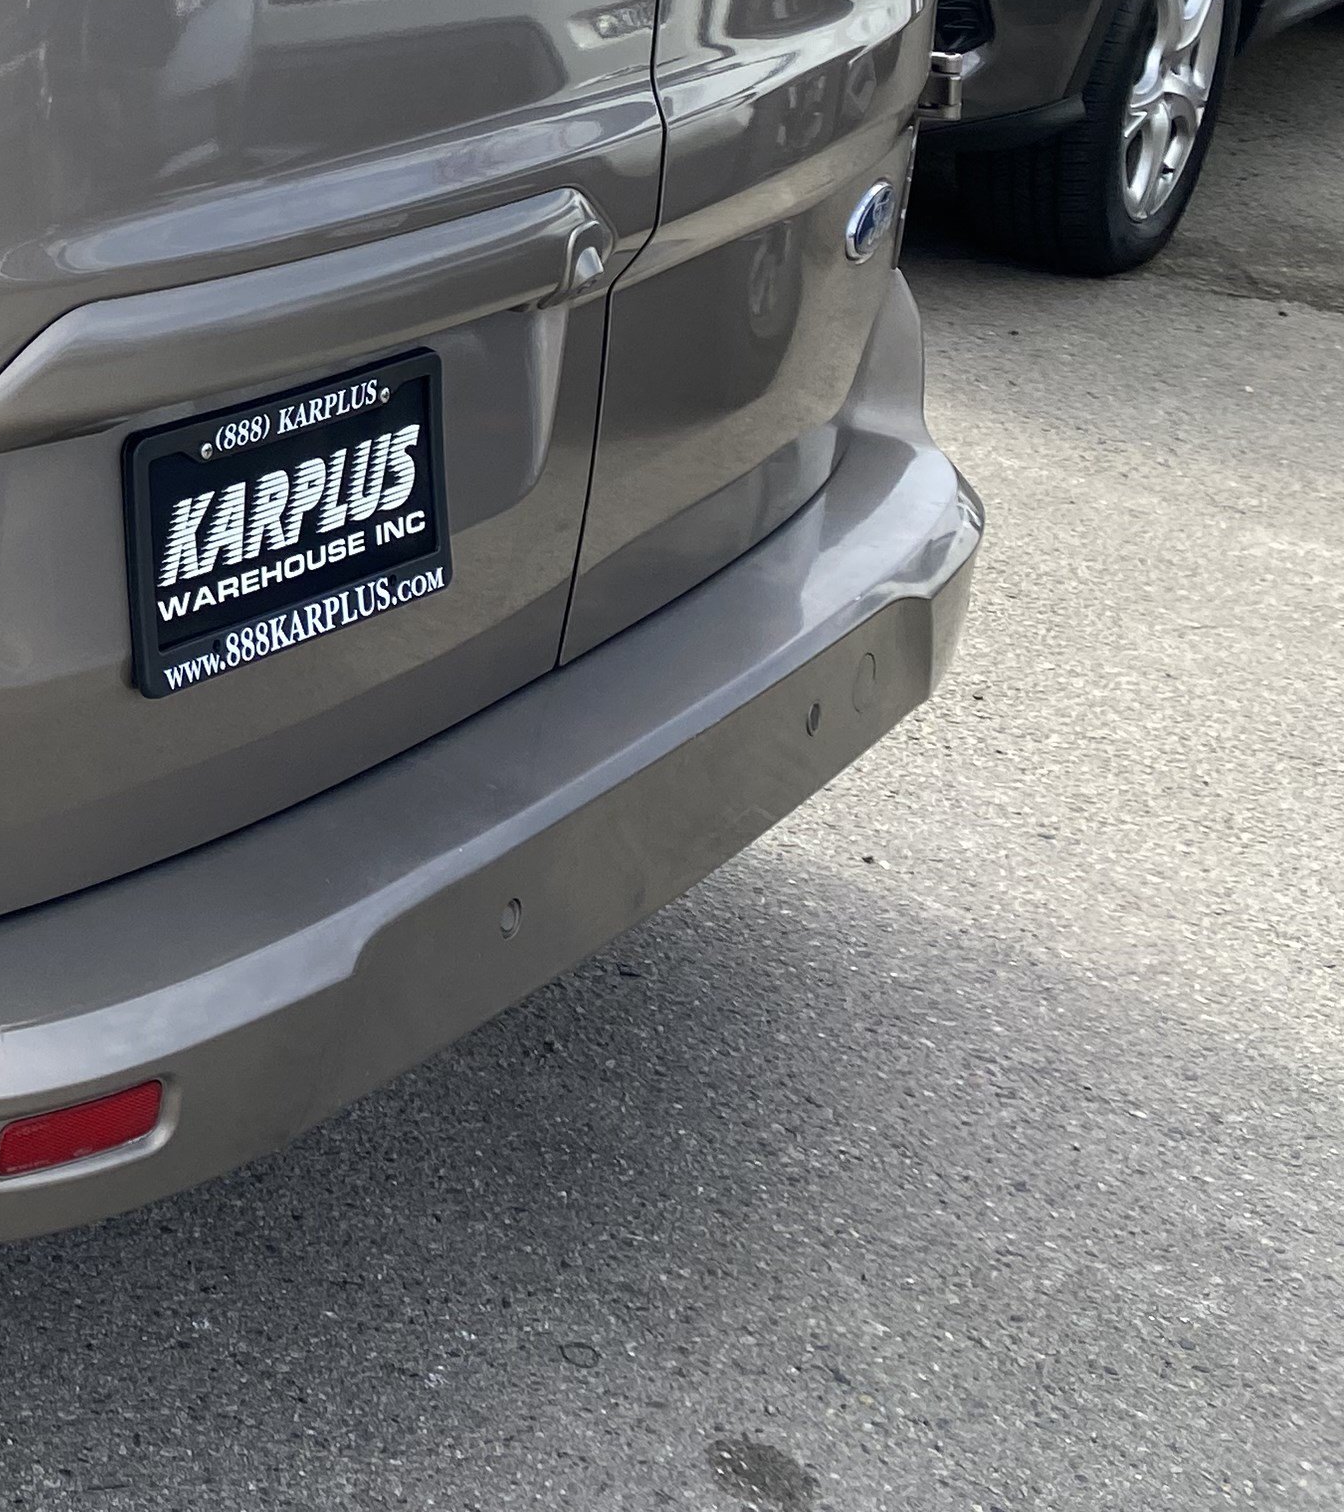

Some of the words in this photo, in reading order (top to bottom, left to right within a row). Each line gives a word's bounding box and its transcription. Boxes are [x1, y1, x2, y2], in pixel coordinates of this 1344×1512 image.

[215, 413, 271, 452] (888)
[277, 379, 379, 435] KARPLUS
[157, 423, 421, 588] KARPLUS
[157, 530, 367, 622] WAREHOUSE
[375, 509, 427, 547] INC
